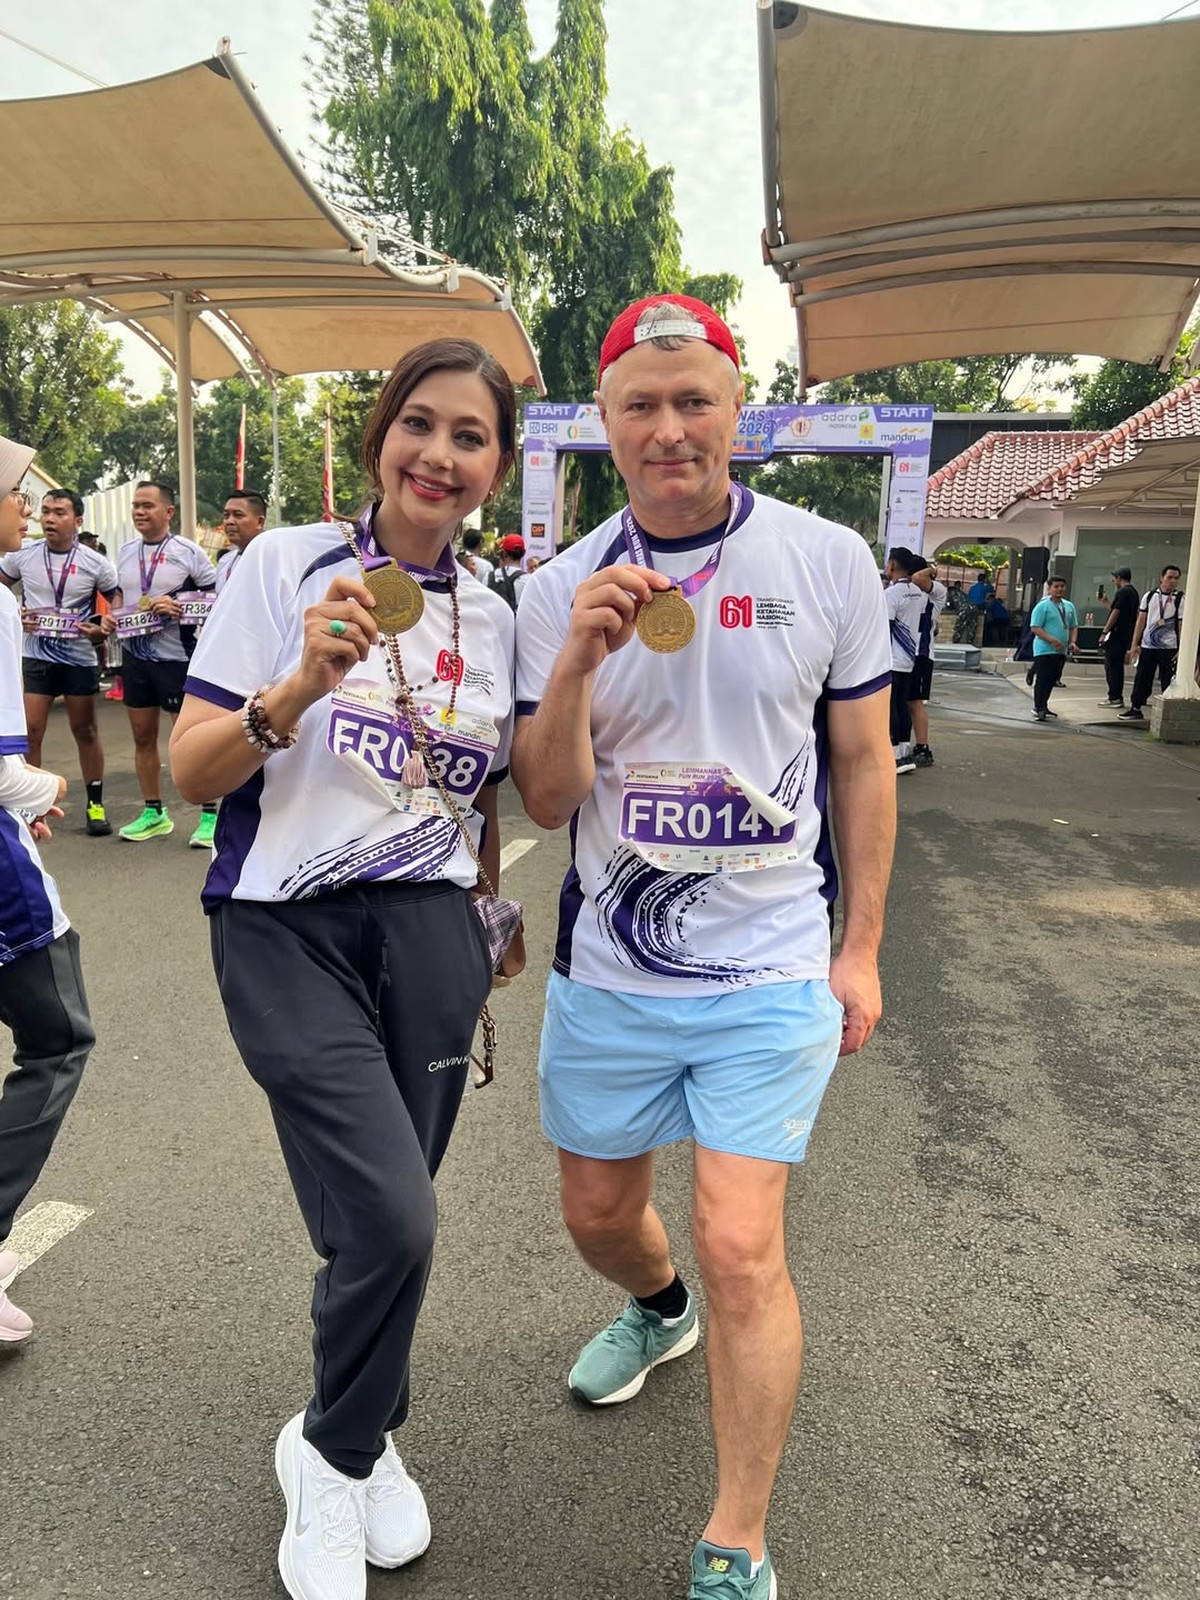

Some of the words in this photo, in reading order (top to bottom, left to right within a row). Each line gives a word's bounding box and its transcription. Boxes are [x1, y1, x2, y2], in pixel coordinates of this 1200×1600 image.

[528, 405, 571, 416] START
[880, 407, 929, 418] START
[822, 413, 857, 421] adaro
[541, 422, 558, 433] BRI
[739, 422, 770, 434] 2026
[719, 594, 753, 629] 61
[756, 608, 795, 616] KETAHANAN
[756, 614, 788, 622] NASIONAL
[333, 718, 478, 788] FR038
[428, 1057, 462, 1072] CALVIN
